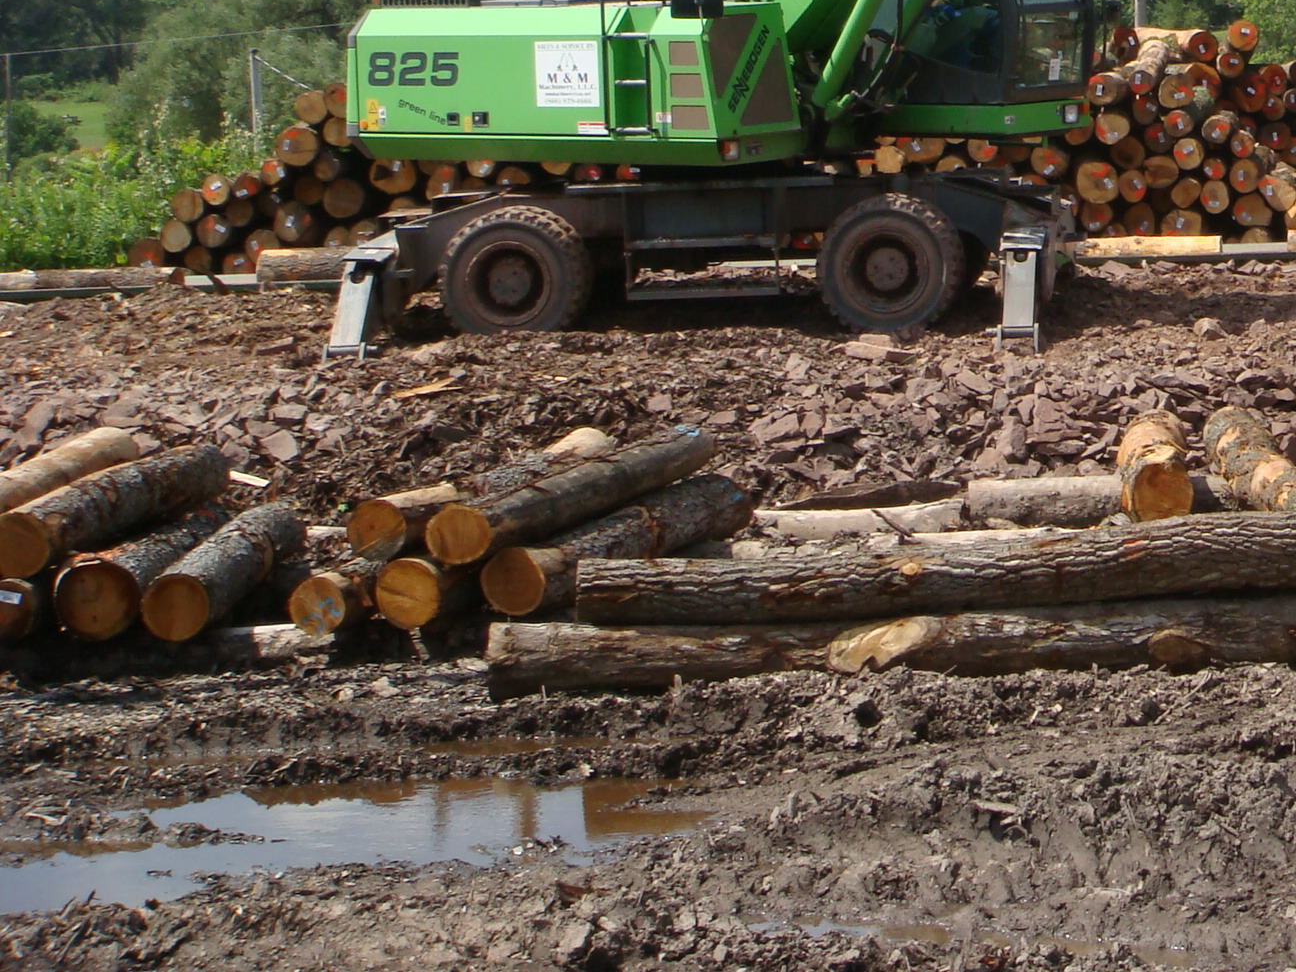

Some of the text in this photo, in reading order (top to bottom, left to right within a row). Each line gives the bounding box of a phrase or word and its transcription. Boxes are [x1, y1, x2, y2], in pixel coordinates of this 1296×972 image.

[368, 51, 460, 86] 825
[547, 73, 588, 83] M & M
[728, 25, 770, 113] SENNEBOGEN
[398, 99, 446, 125] green line
